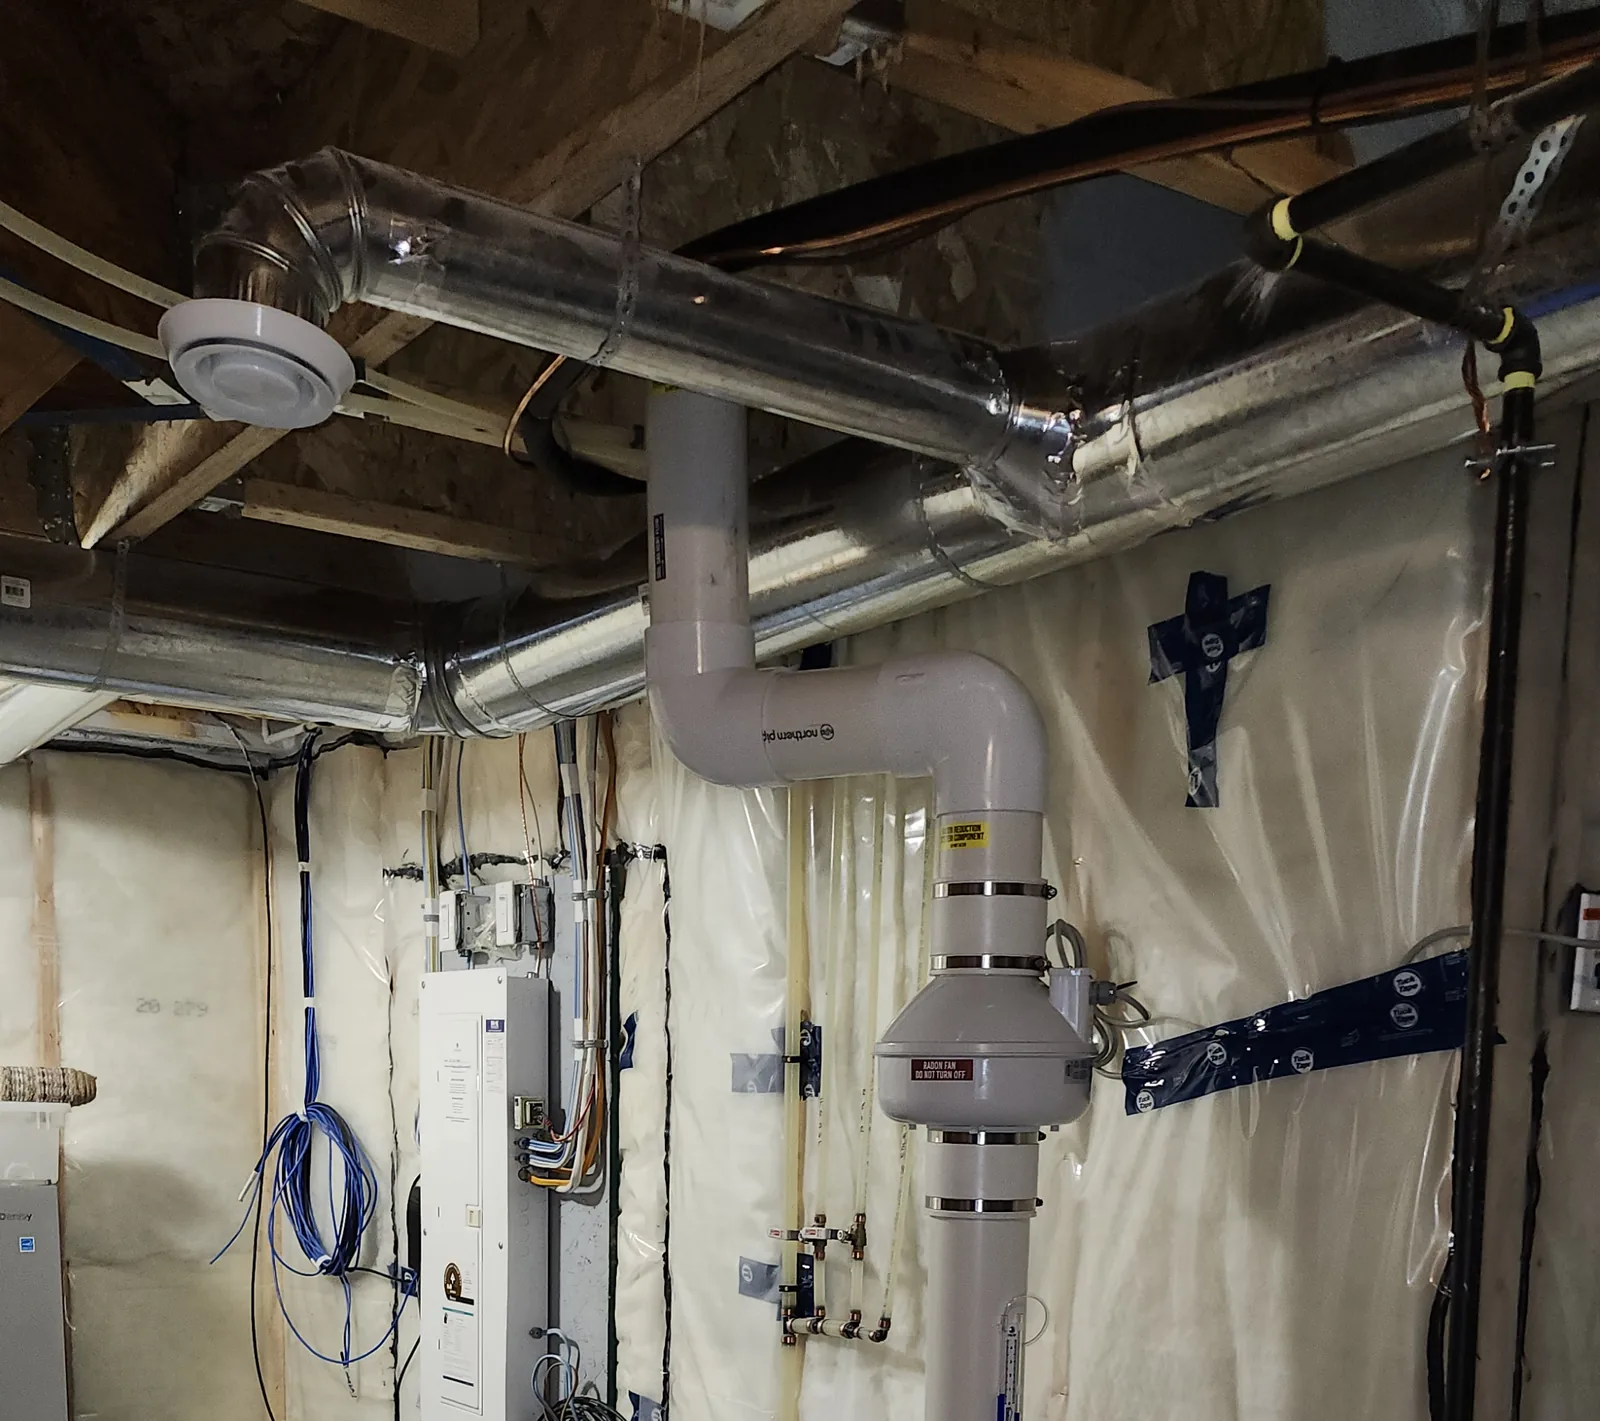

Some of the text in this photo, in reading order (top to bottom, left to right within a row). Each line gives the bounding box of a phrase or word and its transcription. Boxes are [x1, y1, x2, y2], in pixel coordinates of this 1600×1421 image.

[776, 729, 818, 742] northern
[923, 1061, 957, 1070] RADON FAN
[915, 1070, 967, 1079] DO NOT TURN OFF
